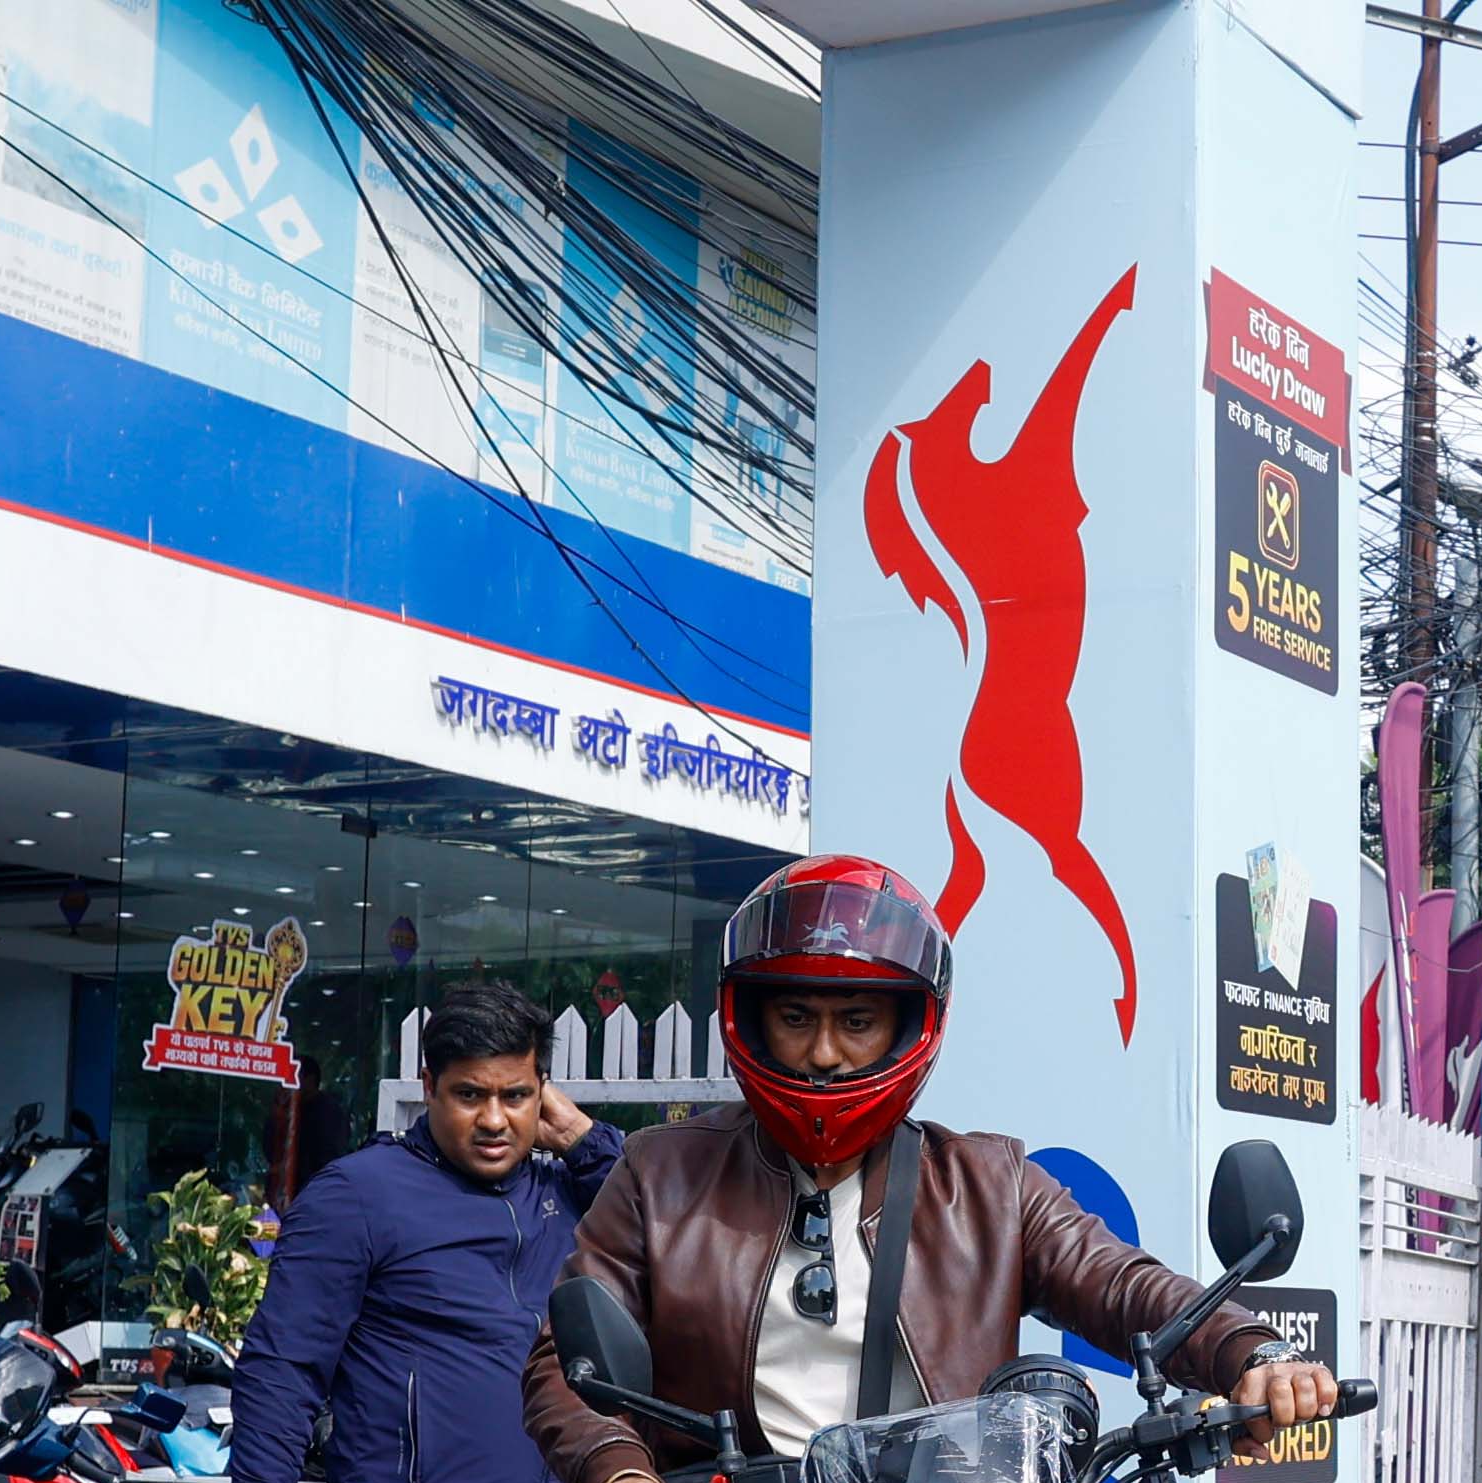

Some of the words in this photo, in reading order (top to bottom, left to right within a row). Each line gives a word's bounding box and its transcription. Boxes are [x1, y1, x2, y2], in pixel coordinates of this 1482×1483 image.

[1283, 327, 1310, 371] दिन
[1232, 335, 1283, 401] Lucky
[1284, 369, 1326, 420] Draw
[775, 572, 803, 591] FREE
[1227, 550, 1251, 634] 5
[1253, 561, 1323, 634] YEARS
[1253, 614, 1283, 652] FREE
[1283, 631, 1332, 673] SERVICE
[572, 707, 632, 769] अटो
[215, 923, 251, 946] TVS
[172, 943, 275, 991] GOLDEN
[173, 983, 269, 1038] KEY
[1264, 990, 1303, 1017] FINANCE
[213, 1039, 230, 1052] TVS
[1239, 1024, 1307, 1067] नागरिकता
[110, 1358, 139, 1373] TVS
